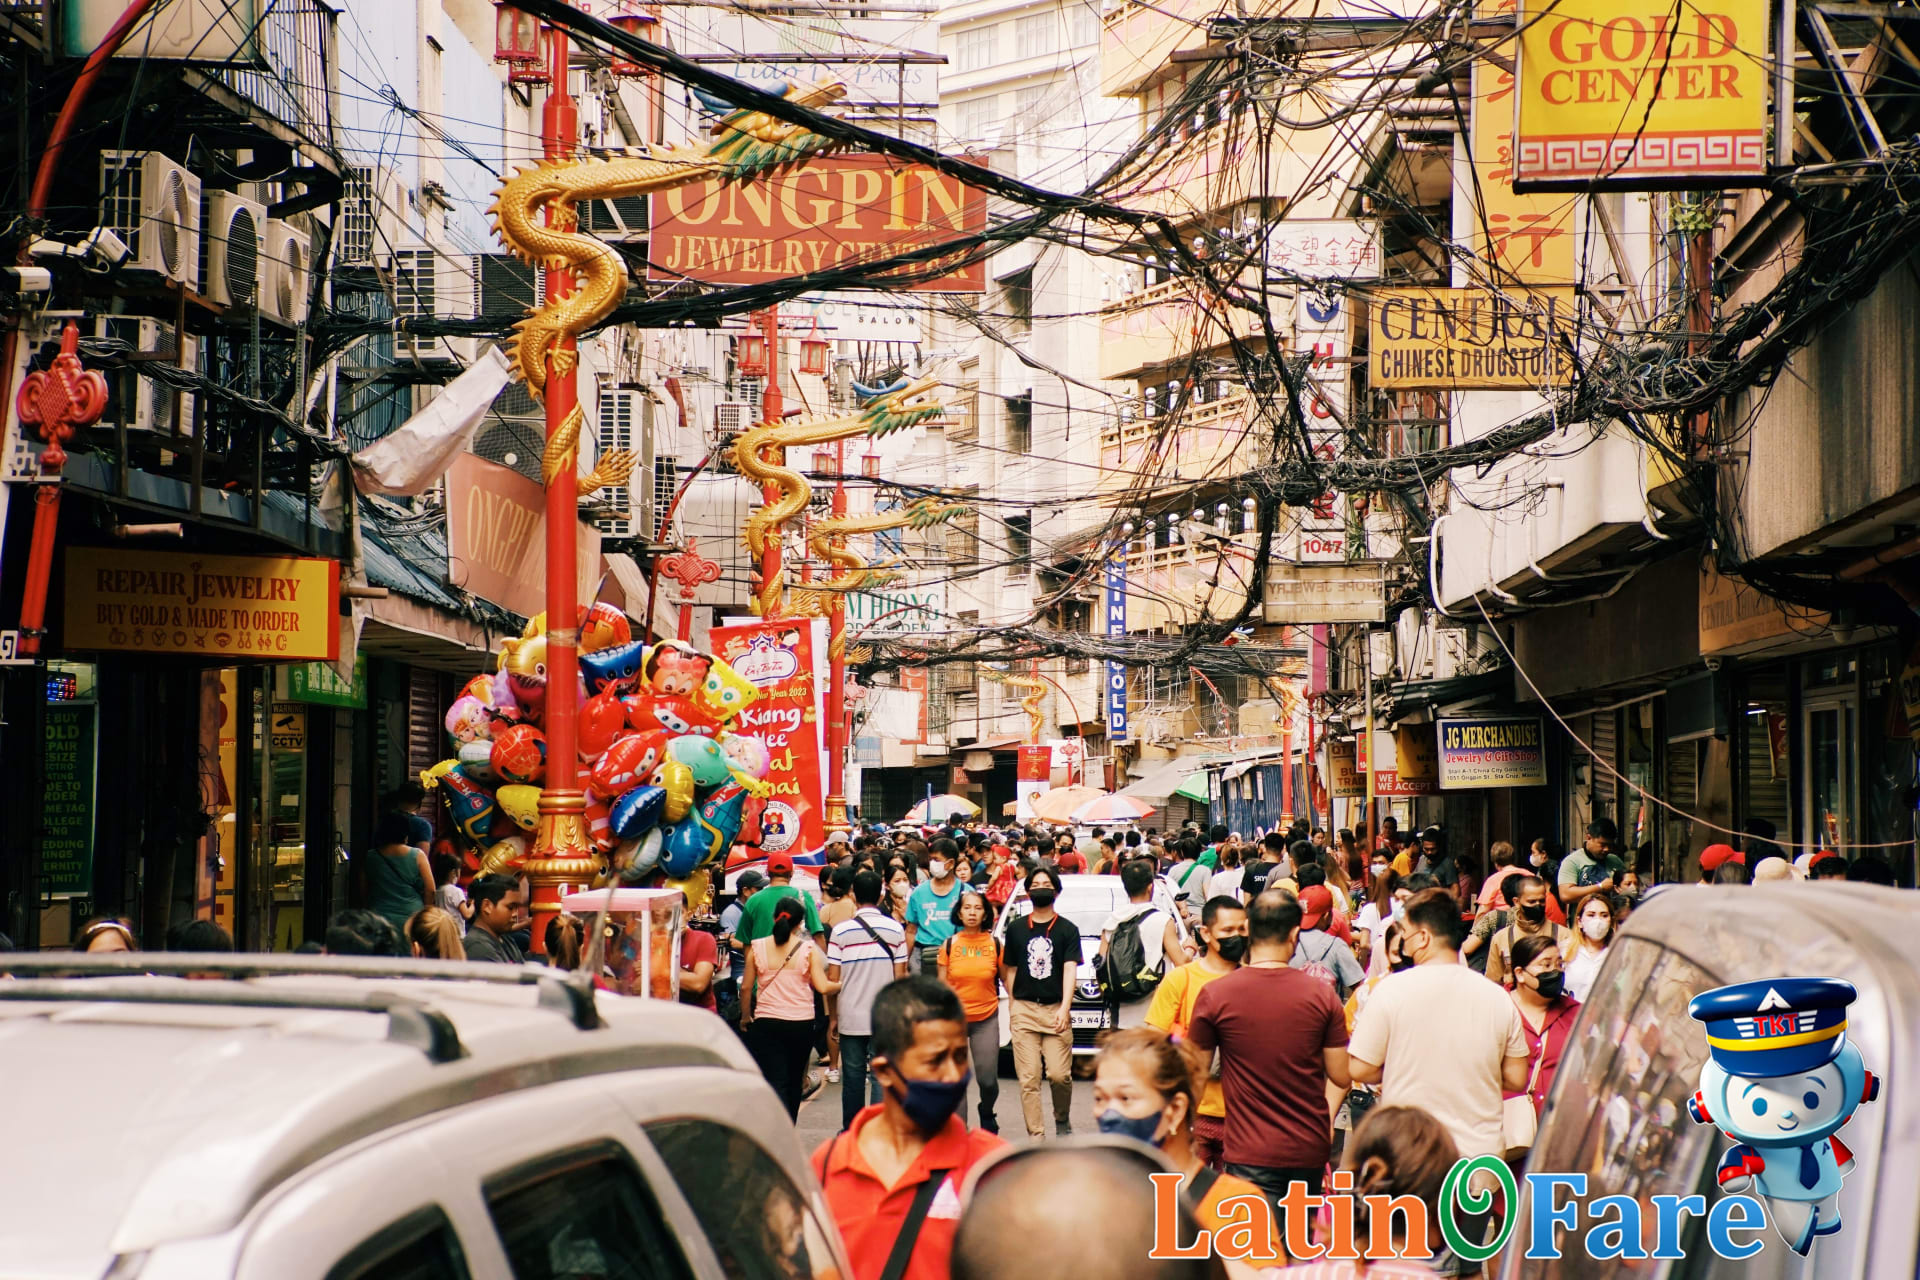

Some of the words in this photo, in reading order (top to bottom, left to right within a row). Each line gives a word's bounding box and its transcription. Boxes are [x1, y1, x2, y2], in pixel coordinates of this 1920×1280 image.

[1549, 13, 1738, 64] GOLD
[1541, 64, 1743, 105] CENTER
[666, 166, 965, 231] ONGPIN
[666, 235, 831, 275] JEWELRY
[858, 315, 915, 325] SALON
[1380, 296, 1566, 342] CENTRAL
[1381, 349, 1455, 378] CHINESE
[1461, 348, 1564, 378] DRUGSTORE
[1303, 540, 1342, 553] 1047
[97, 568, 186, 596] REPAIR
[97, 603, 127, 625] BUY
[130, 605, 168, 626] GOLD
[172, 607, 183, 627] &
[186, 607, 228, 629] MADE
[231, 609, 250, 630] TO
[252, 610, 300, 632] ORDER
[870, 593, 939, 621] HIONG
[788, 687, 807, 697] 2023
[54, 713, 79, 723] BUY
[272, 737, 303, 747] CCTV
[1445, 727, 1460, 749] JG
[1462, 724, 1537, 748] MERCHANDISE
[1446, 752, 1482, 765] Jewelry
[1484, 751, 1492, 761] &
[1494, 751, 1512, 762] Gift
[1514, 750, 1538, 762] Shop
[1377, 782, 1393, 791] WE
[1395, 782, 1432, 791] ACCEPT
[1378, 773, 1393, 783] WE
[65, 804, 86, 813] TAG
